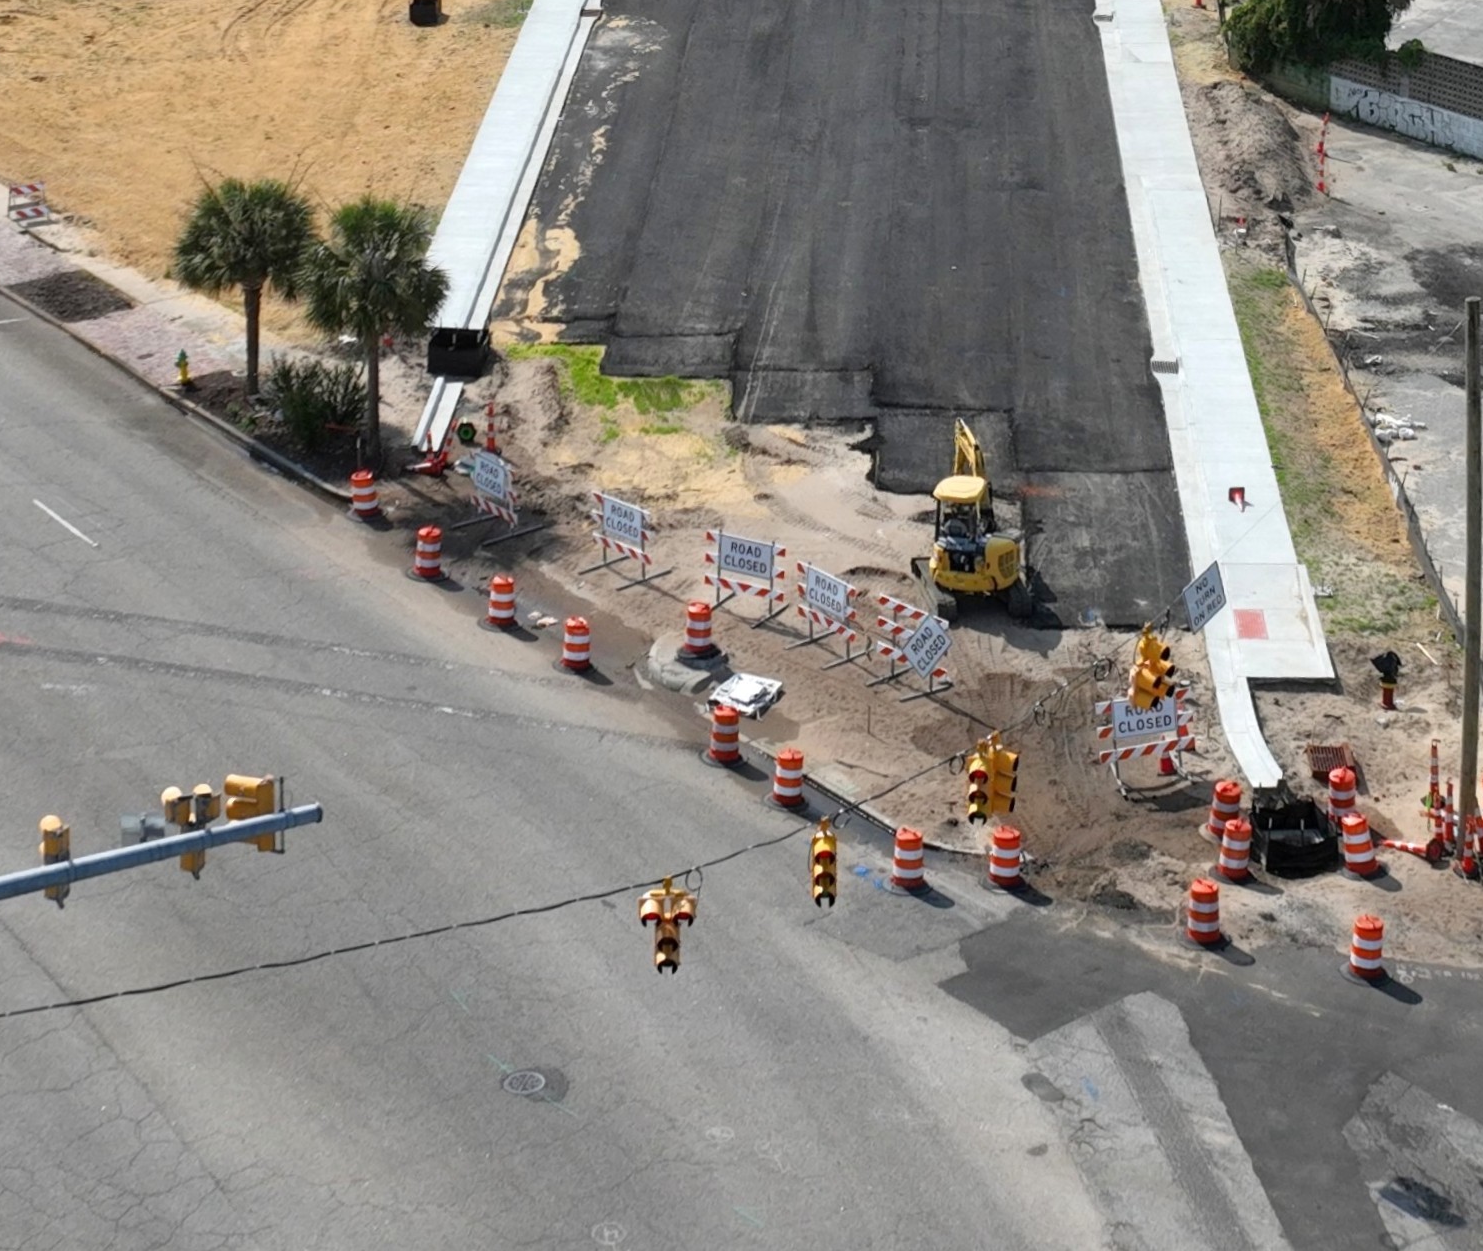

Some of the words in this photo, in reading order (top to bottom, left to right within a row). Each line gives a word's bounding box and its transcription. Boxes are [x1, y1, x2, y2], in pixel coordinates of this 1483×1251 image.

[480, 461, 499, 479] ROAD
[477, 472, 502, 494] CLOSED
[611, 504, 635, 522] ROAD
[606, 517, 639, 538] CLOSED
[731, 542, 762, 558] ROAD
[724, 554, 767, 573] CLOSED
[815, 575, 838, 596] ROAD
[1195, 577, 1208, 594] NO
[809, 588, 842, 613] CLOSED
[1195, 585, 1216, 610] TURN
[1194, 611, 1205, 626] ON
[1207, 594, 1222, 614] RED
[911, 627, 933, 655] ROAD
[917, 634, 946, 671] CLOSED
[1125, 701, 1163, 716] ROD
[1118, 715, 1172, 734] CLOSED
